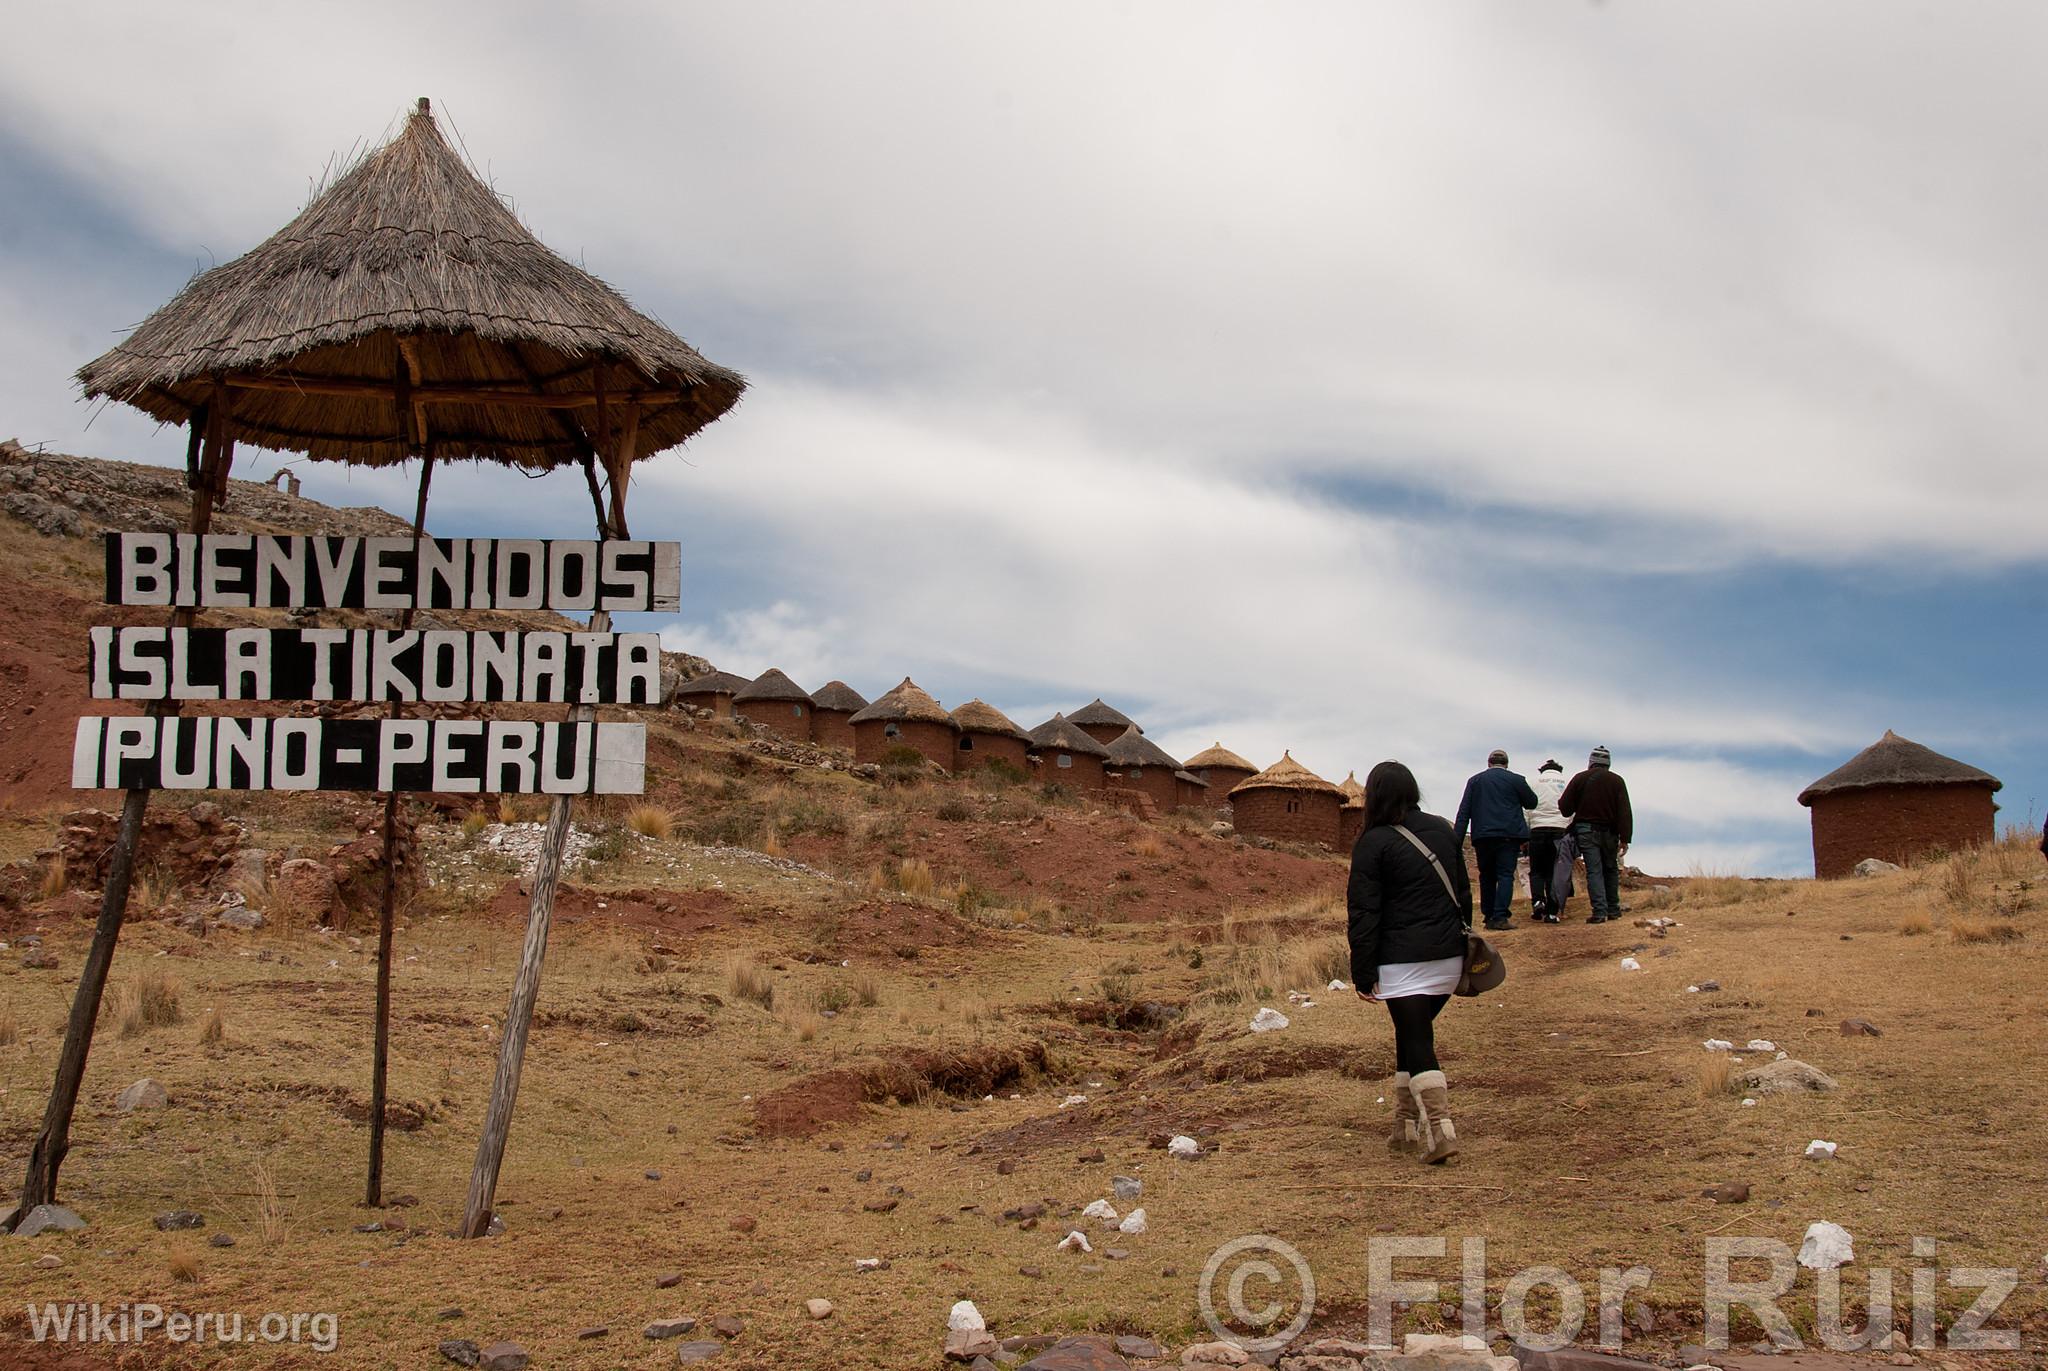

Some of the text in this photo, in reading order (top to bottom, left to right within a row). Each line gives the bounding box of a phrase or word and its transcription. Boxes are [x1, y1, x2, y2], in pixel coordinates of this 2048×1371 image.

[120, 533, 651, 612] BIENVENIDOS
[91, 626, 661, 704] ISLA TIKONATA
